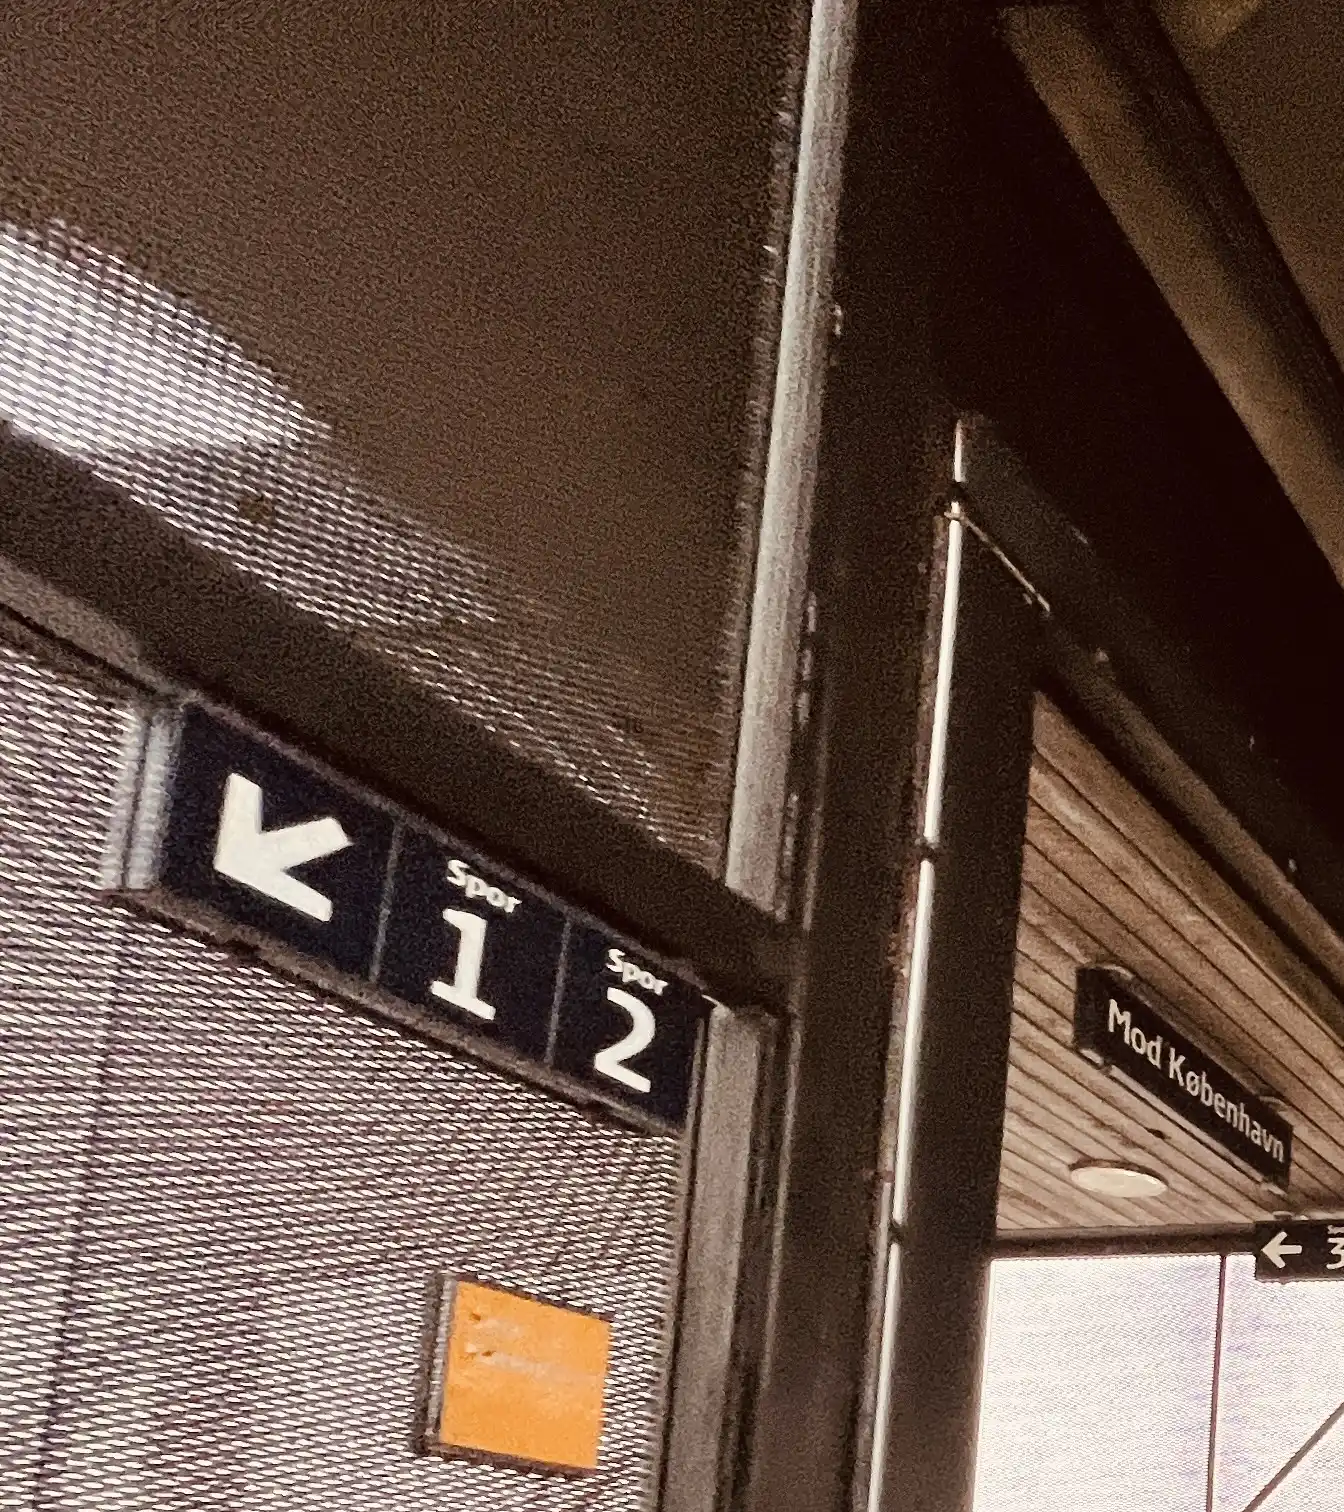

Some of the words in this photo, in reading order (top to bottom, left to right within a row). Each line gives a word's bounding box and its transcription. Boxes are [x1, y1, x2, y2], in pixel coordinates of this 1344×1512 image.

[447, 859, 523, 914] Spor
[429, 908, 496, 1021] 1
[605, 948, 669, 996] Spor
[593, 987, 656, 1093] 2
[1108, 998, 1163, 1070] Mod
[1169, 1047, 1285, 1163] København
